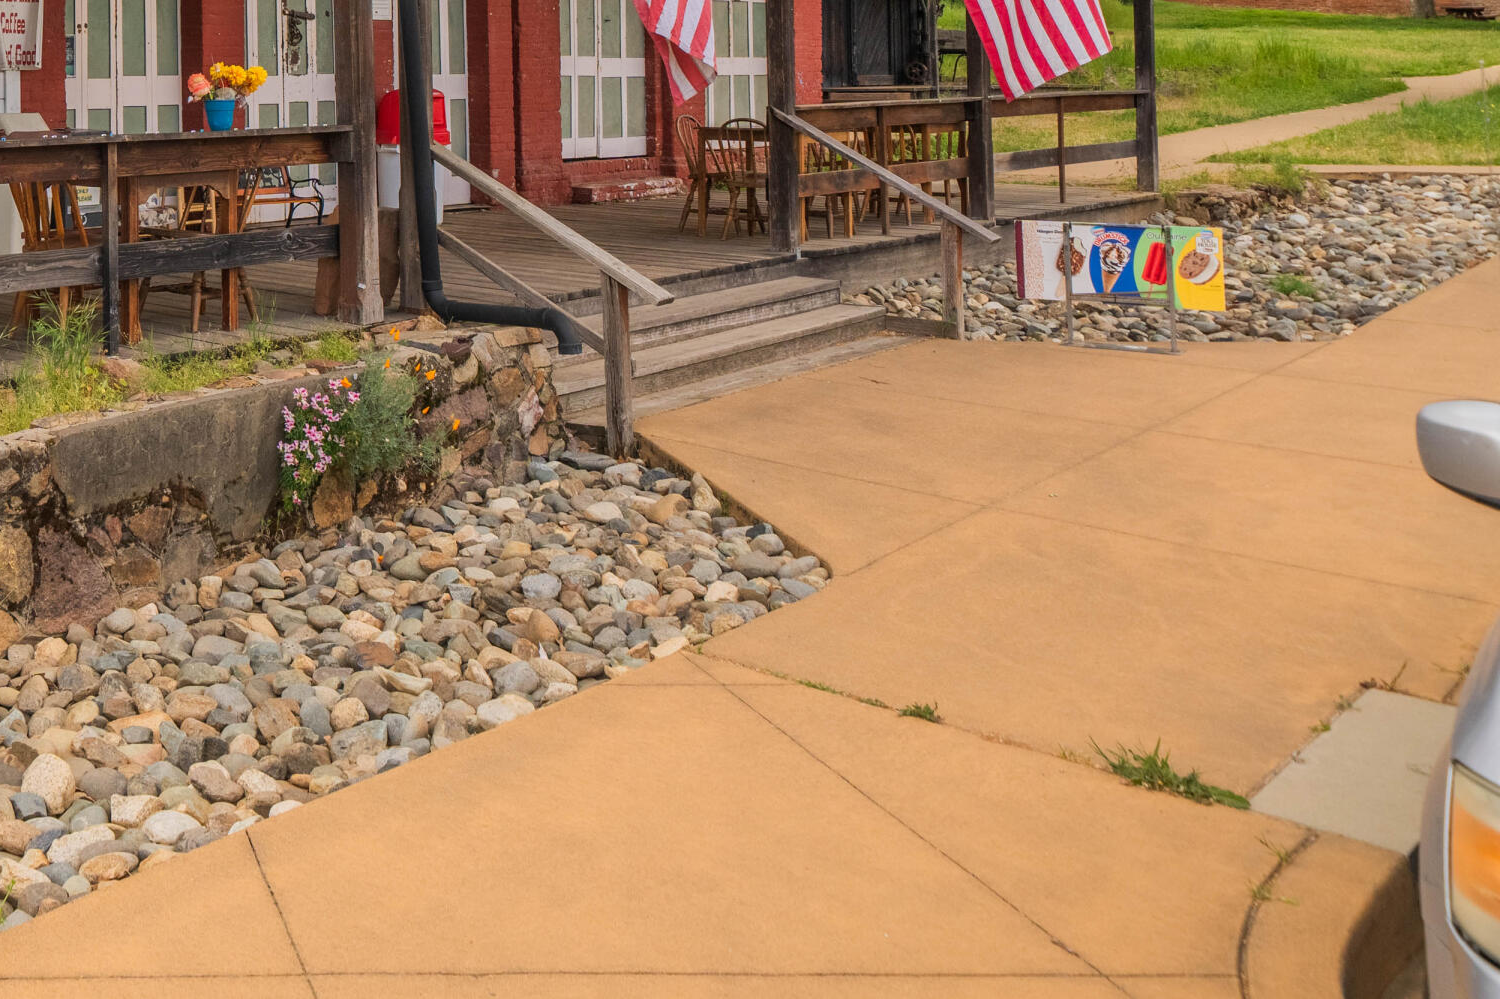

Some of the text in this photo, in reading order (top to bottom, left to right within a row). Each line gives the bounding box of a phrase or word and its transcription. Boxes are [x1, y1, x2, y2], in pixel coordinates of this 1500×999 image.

[1, 12, 26, 34] Coffee
[16, 44, 37, 65] Good
[1094, 232, 1130, 247] DRUMSTICK
